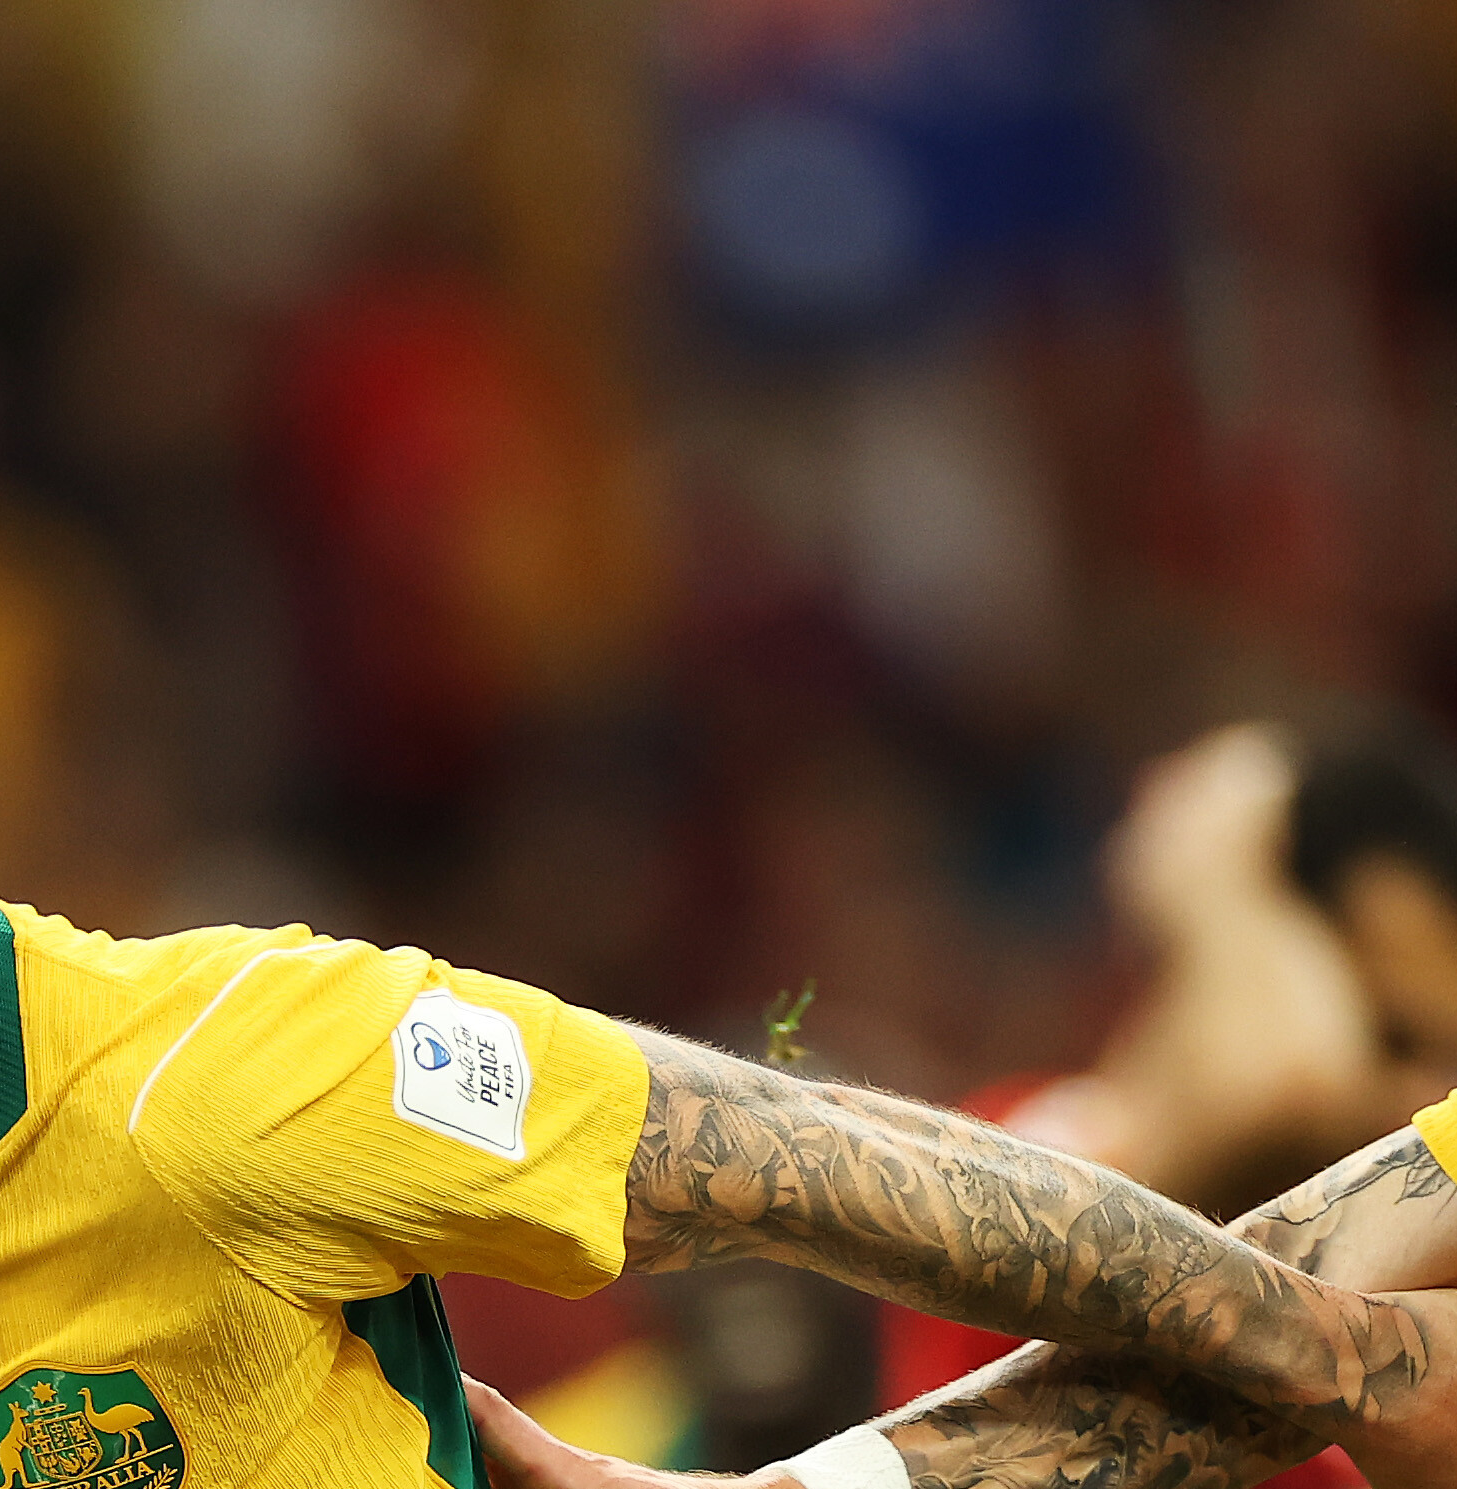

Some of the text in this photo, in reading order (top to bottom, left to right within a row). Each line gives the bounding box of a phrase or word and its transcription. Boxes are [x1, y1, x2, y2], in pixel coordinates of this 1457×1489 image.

[452, 1024, 478, 1103] Unite For
[477, 1035, 500, 1107] PEACE
[503, 1064, 514, 1100] FIFA
